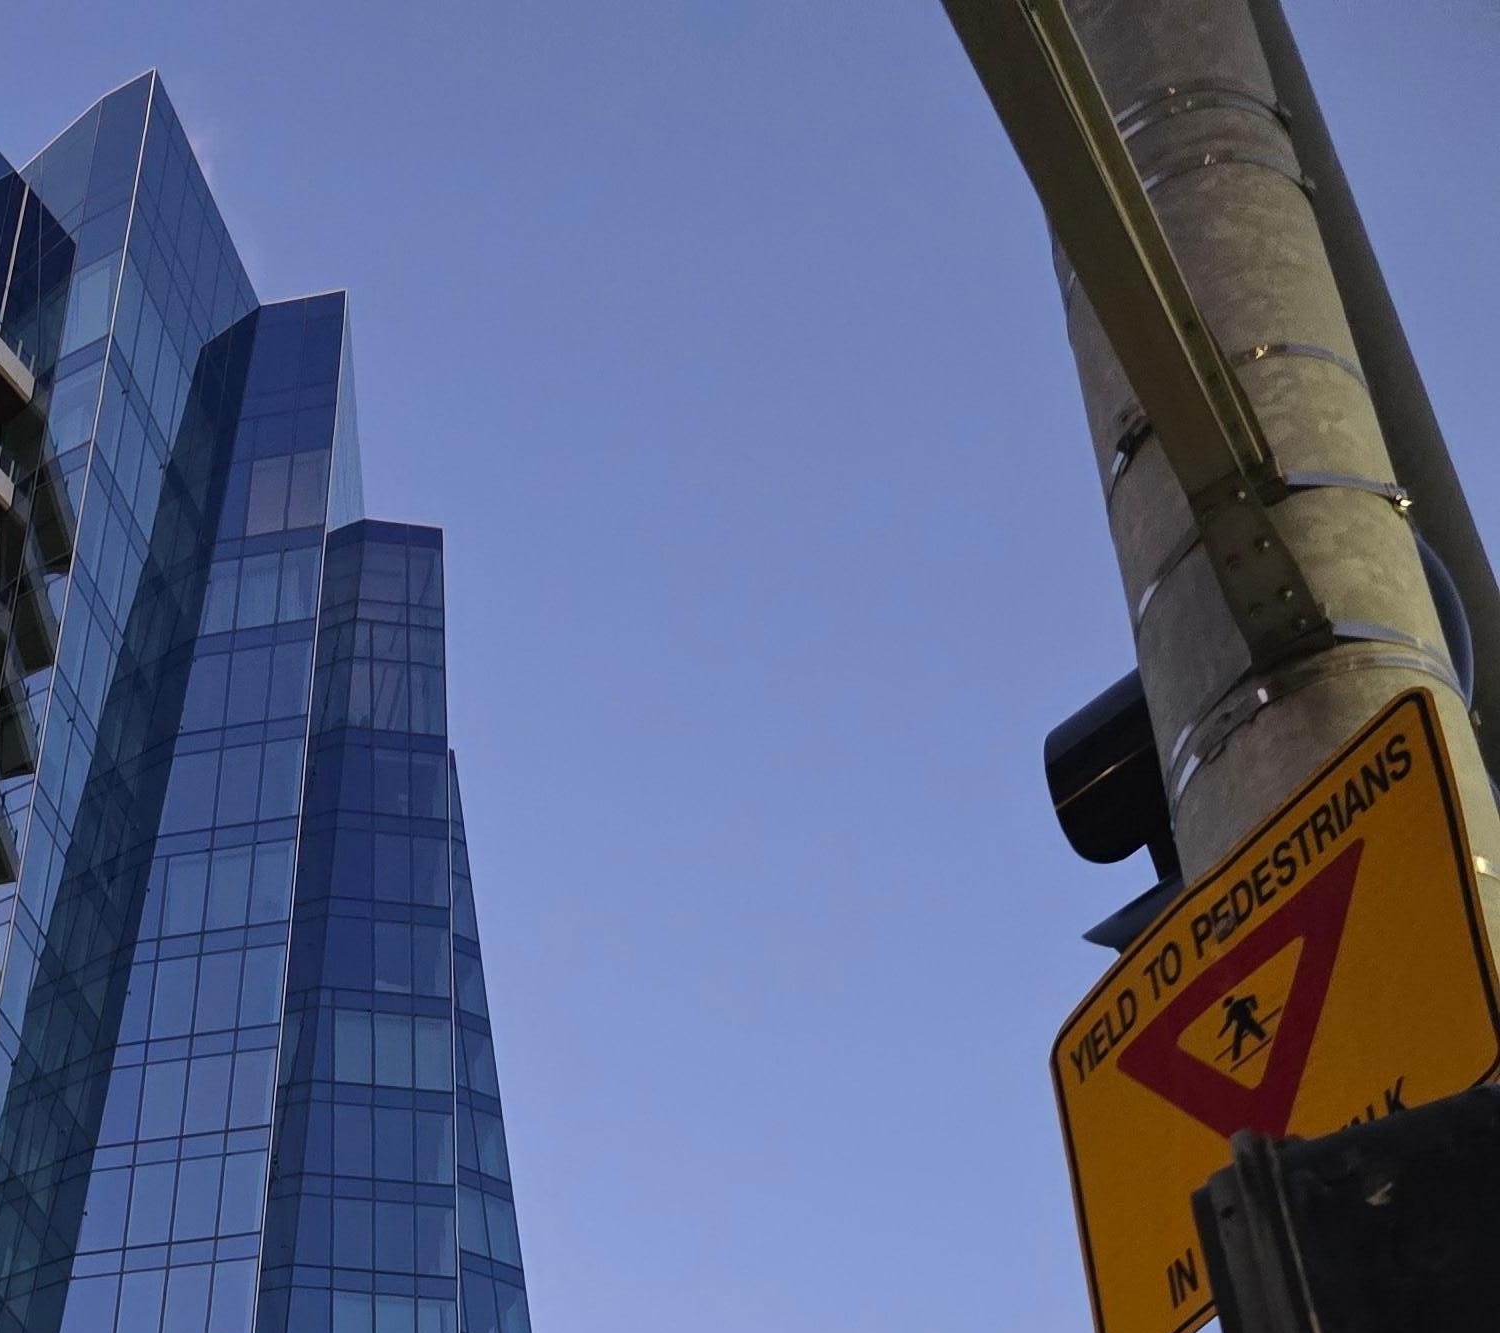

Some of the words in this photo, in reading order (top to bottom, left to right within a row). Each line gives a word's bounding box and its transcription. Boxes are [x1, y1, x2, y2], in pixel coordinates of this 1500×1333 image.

[1070, 988, 1138, 1084] YIELD
[1143, 940, 1183, 1000] TO
[1190, 733, 1413, 960] PEDESTRIANS
[1167, 1247, 1198, 1309] IN
